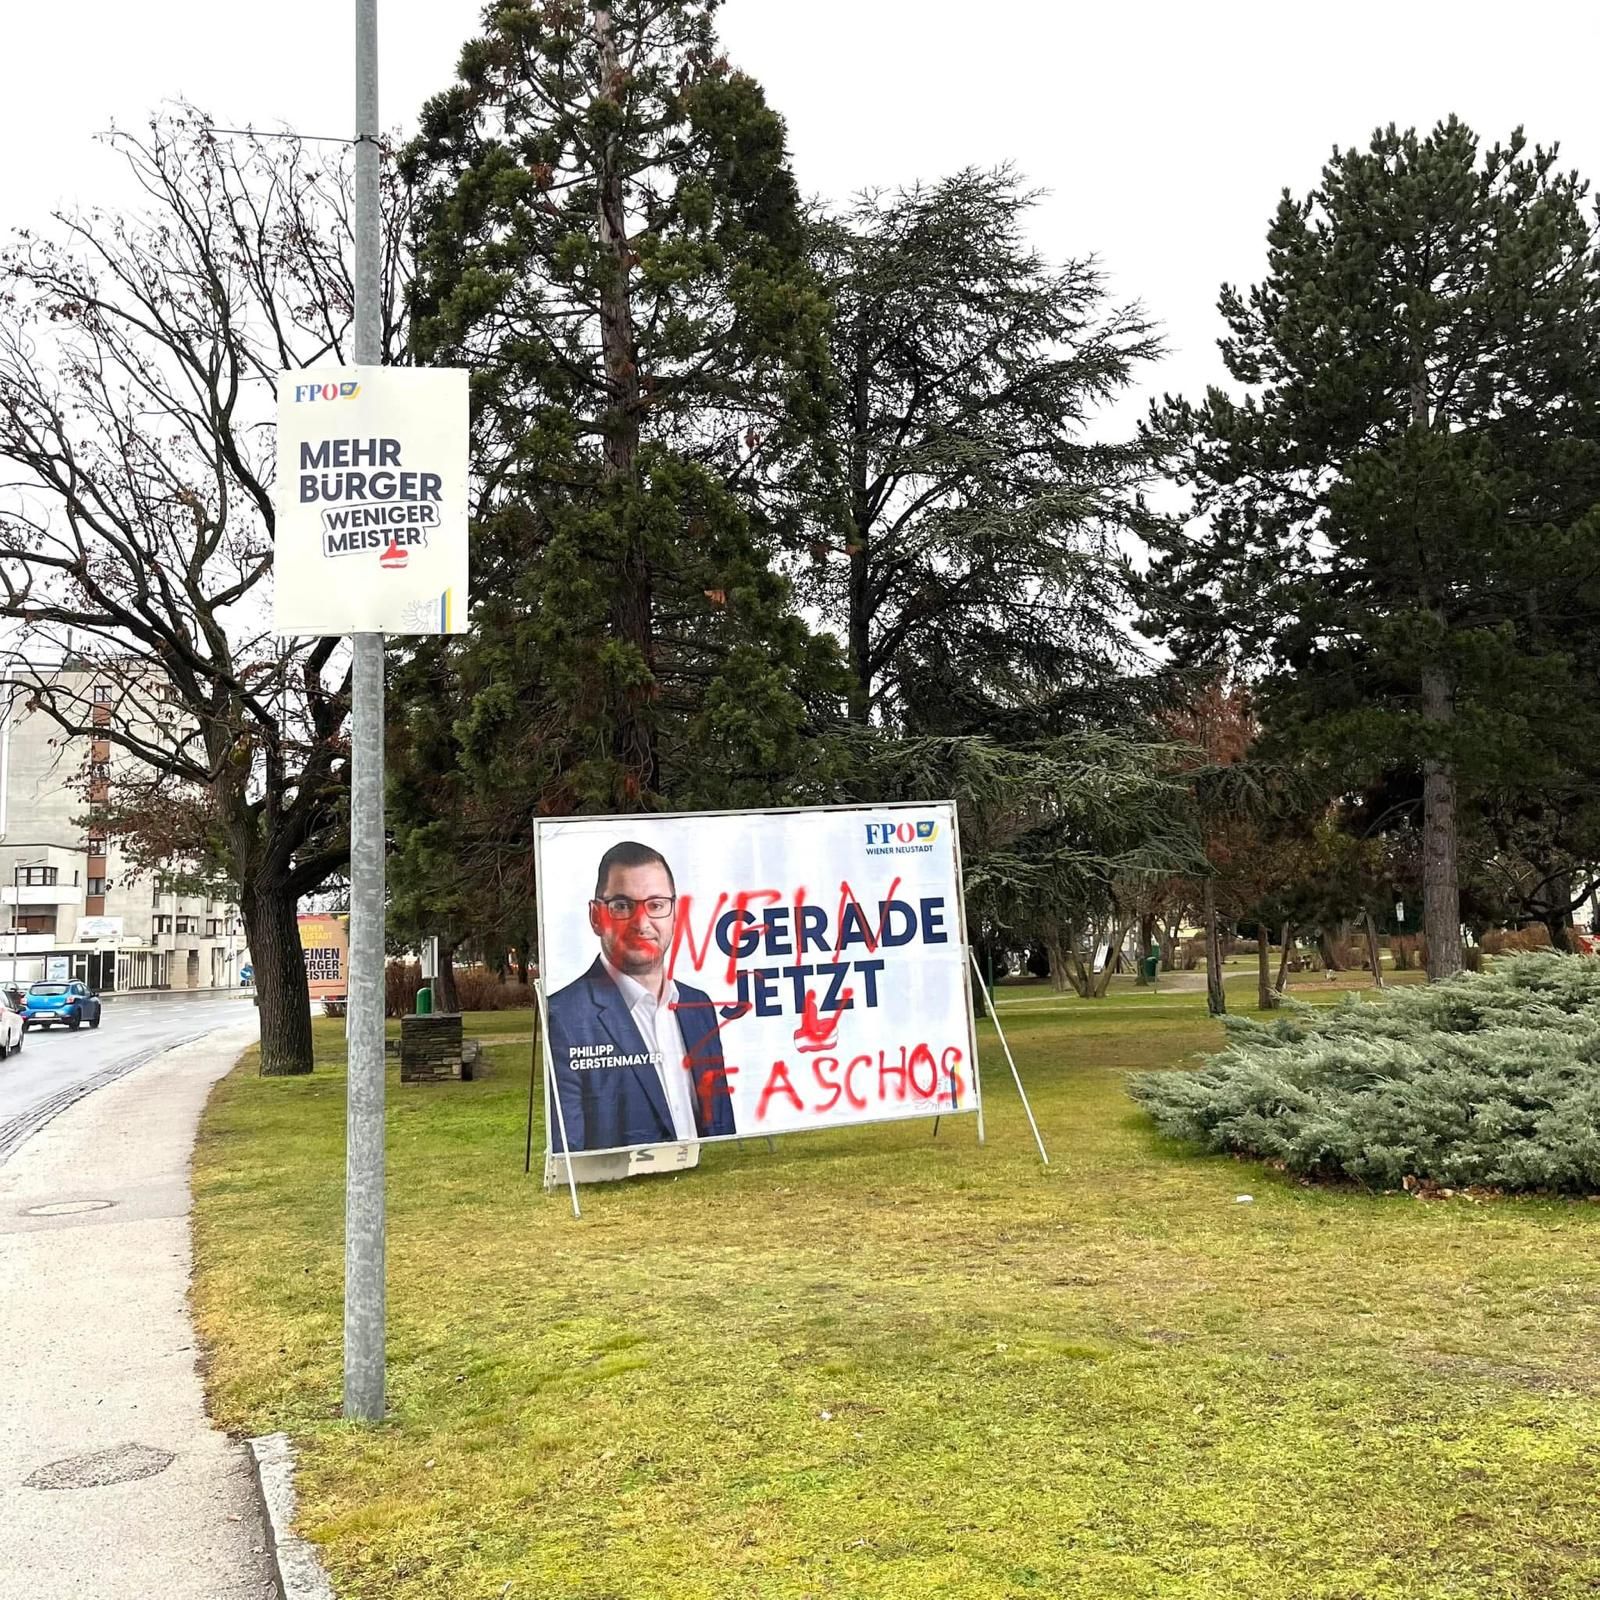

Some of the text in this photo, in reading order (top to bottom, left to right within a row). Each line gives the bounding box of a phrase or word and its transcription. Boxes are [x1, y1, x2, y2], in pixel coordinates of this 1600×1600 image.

[300, 438, 402, 469] MEHR
[300, 471, 443, 503] BÜRGER
[327, 504, 434, 530] WENIGER
[328, 527, 421, 552] MEISTER
[866, 845, 933, 855] WIENER NEUSTADT
[667, 876, 901, 985] NEIN
[715, 897, 948, 959] GERADE
[303, 948, 340, 959] EINEN
[306, 971, 342, 980] EISTER.
[719, 959, 885, 1020] JETZT
[569, 1045, 614, 1058] PHILIPP
[570, 1053, 664, 1070] GERSTENMAYER
[697, 1043, 966, 1122] FASCHOS
